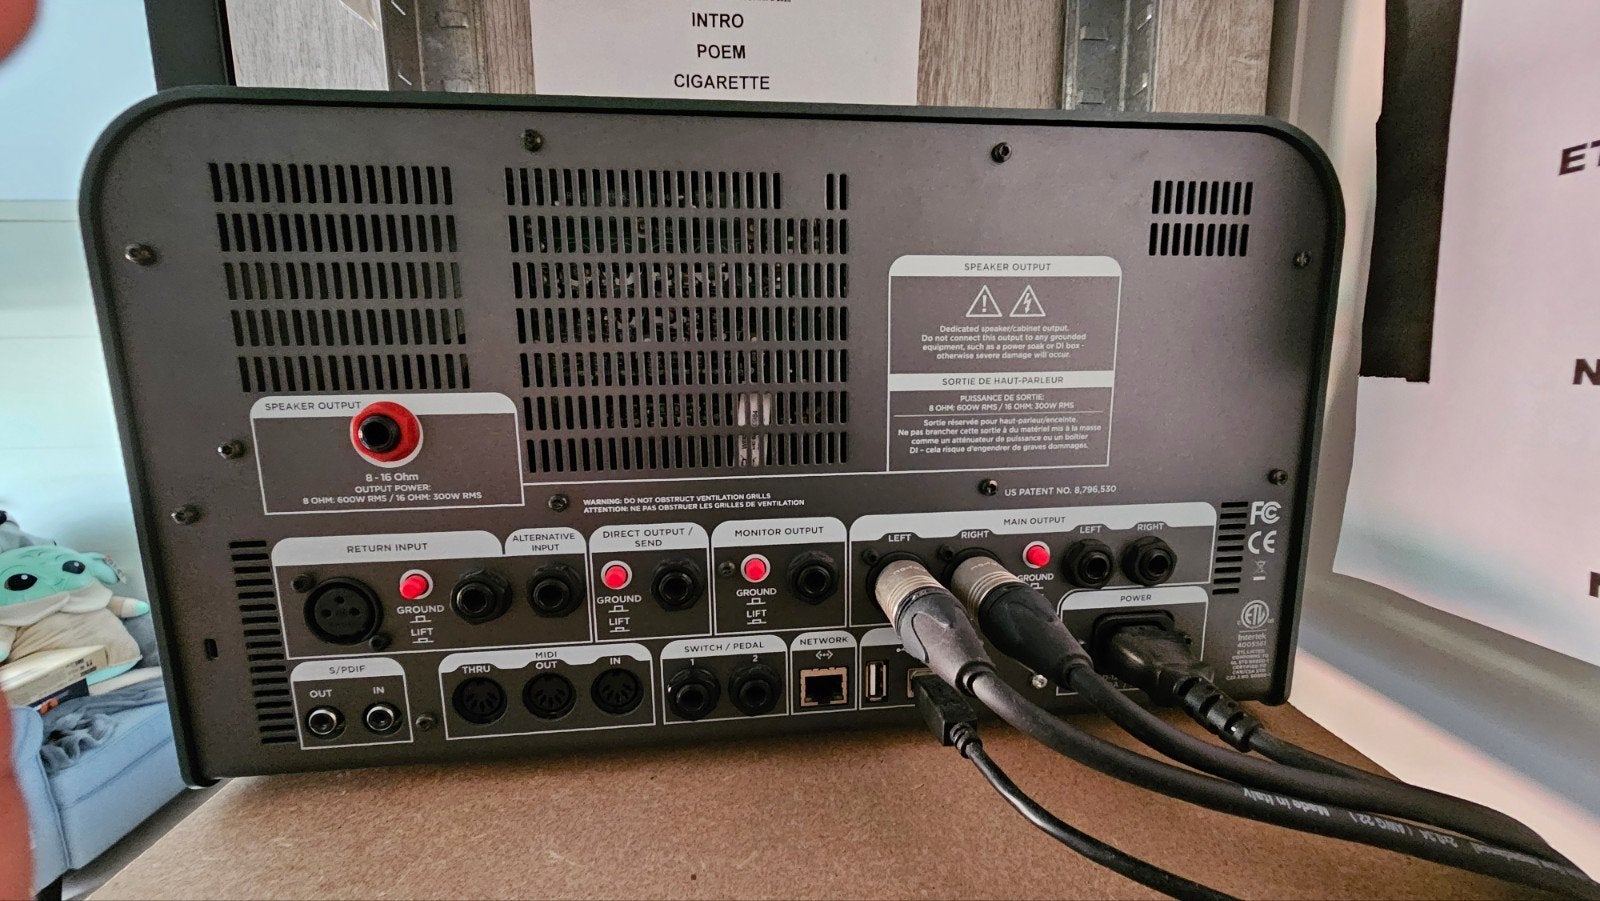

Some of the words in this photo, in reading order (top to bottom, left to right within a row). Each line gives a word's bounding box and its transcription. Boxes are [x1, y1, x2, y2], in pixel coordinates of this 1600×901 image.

[692, 12, 744, 28] INTRO
[697, 44, 745, 59] POEM
[674, 74, 770, 89] CIGARETTE
[964, 263, 1009, 271] SPEAKER
[1012, 263, 1051, 271] OUTPUT
[981, 325, 1040, 333] speaker/cabinet
[923, 343, 965, 351] equipment,
[1002, 352, 1032, 360] damage
[942, 378, 975, 386] SORTIE
[994, 376, 1063, 384] HAUT-PARLEUR
[265, 402, 315, 411] SPEAKER
[318, 401, 361, 410] OUTPUT
[948, 418, 978, 426] réservée
[952, 435, 993, 443] atténuateur
[1007, 434, 1041, 443] puissance
[943, 445, 965, 454] risque
[1023, 443, 1046, 451] graves
[1048, 442, 1088, 450] dommages.
[381, 473, 390, 481] 16
[394, 473, 419, 481] Ohm
[355, 485, 392, 493] OUTPUT
[395, 484, 431, 492] POWER:
[1004, 488, 1015, 496] US
[1018, 487, 1053, 496] PATENT
[1056, 486, 1072, 495] NO.
[1074, 484, 1116, 495] 8,796,530
[311, 496, 334, 504] OHM:
[337, 495, 365, 503] 600W
[396, 494, 405, 502] 16
[407, 493, 431, 501] OHM:
[433, 492, 460, 500] 300W
[655, 495, 694, 503] OBSTRUCT
[696, 494, 744, 502] VENTILATION
[584, 505, 628, 513] ATTENTION:
[658, 503, 697, 511] OBSTRUER
[714, 501, 744, 509] GRILLES
[758, 499, 804, 507] VENTILATION
[1004, 517, 1027, 526] MAIN
[1030, 516, 1066, 524] OUTPUT
[735, 527, 781, 537] MONITOR
[785, 526, 823, 535] OUTPUT
[1080, 525, 1101, 534] LEFT
[1137, 522, 1164, 531] RIGHT
[513, 533, 575, 542] ALTERNATIVE
[603, 529, 639, 538] DIRECT
[644, 528, 684, 536] OUTPUT
[689, 527, 693, 535] /
[961, 530, 989, 539] RIGHT
[635, 539, 662, 547] SEND
[888, 534, 911, 542] LEFT
[1248, 531, 1277, 554] CE
[347, 544, 391, 553] RETURN
[395, 542, 427, 551] INPUT
[532, 543, 559, 552] INPUT
[736, 587, 777, 597] GROUND
[597, 594, 642, 604] GROUND
[1121, 594, 1151, 602] POWER
[396, 604, 444, 615] GROUND
[747, 609, 767, 618] LIFT
[609, 617, 630, 626] LIFT
[411, 627, 433, 637] LIFT
[800, 636, 848, 646] NETWORK
[684, 643, 722, 653] SWITCH
[725, 643, 730, 651] /
[733, 641, 764, 650] PEDAL
[535, 651, 557, 659] MIDI
[535, 661, 557, 670] OUT
[610, 657, 620, 665] IN
[329, 665, 365, 675] S/PDIF
[462, 664, 490, 674] THRU
[310, 689, 332, 698] OUT
[373, 686, 384, 694] IN
[1244, 788, 1274, 806] Italy
[1276, 796, 1290, 809] in
[1292, 800, 1330, 817] Made
